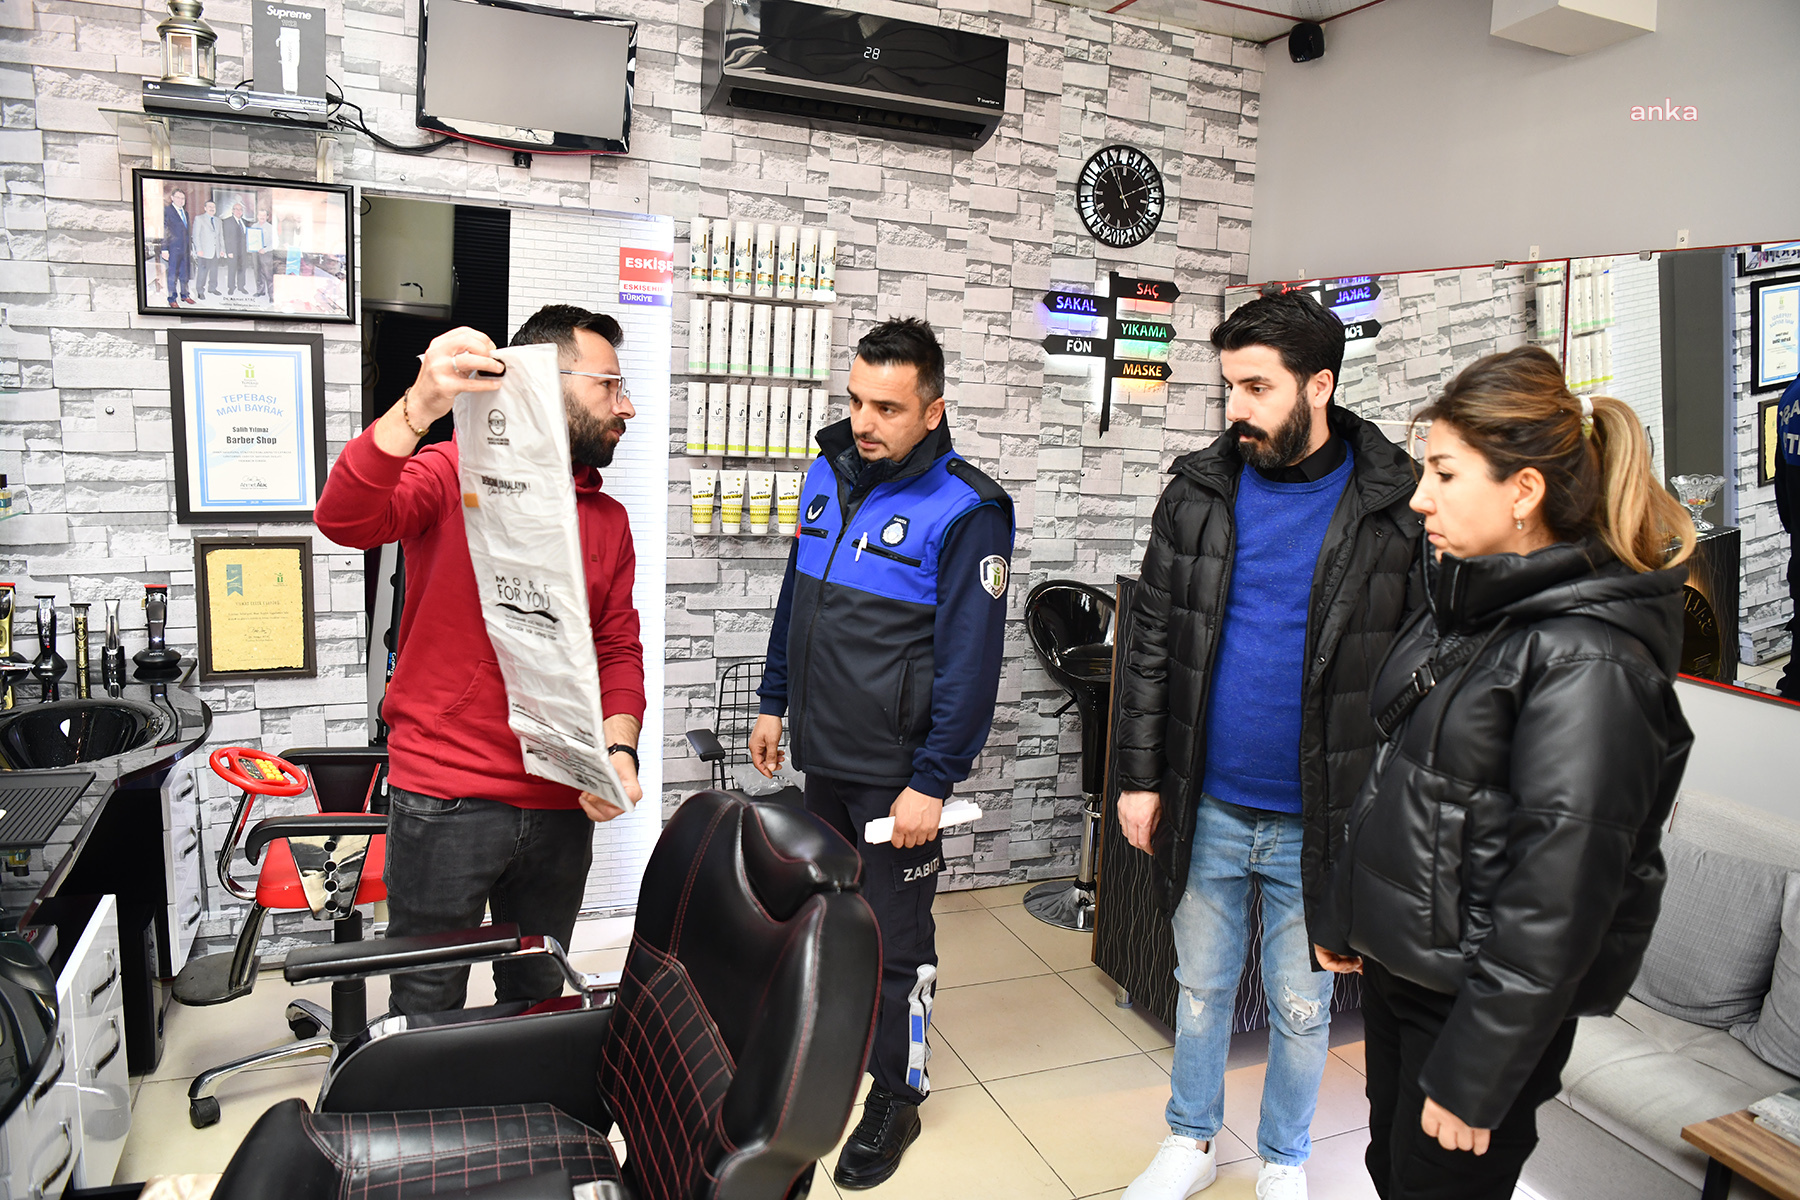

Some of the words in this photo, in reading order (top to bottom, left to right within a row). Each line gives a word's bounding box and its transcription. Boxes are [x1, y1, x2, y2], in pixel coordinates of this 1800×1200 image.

[266, 5, 312, 20] Supreme
[863, 47, 881, 60] 28
[621, 293, 653, 303] TÜRKİYE
[1136, 282, 1160, 299] SAÇ
[1056, 295, 1098, 312] SAKAL
[1121, 322, 1168, 338] YIKAMA
[1066, 338, 1092, 353] FÖN
[1122, 362, 1163, 377] MASKE
[221, 393, 277, 406] TEPEBAŞI
[216, 403, 241, 417] MAVİ
[244, 403, 284, 418] BAYRAK
[226, 436, 254, 444] Barber
[256, 436, 277, 445] Shop
[495, 575, 551, 594] MORE
[497, 584, 521, 602] FOR
[524, 590, 551, 610] YOU
[903, 857, 940, 882] ZABIT
